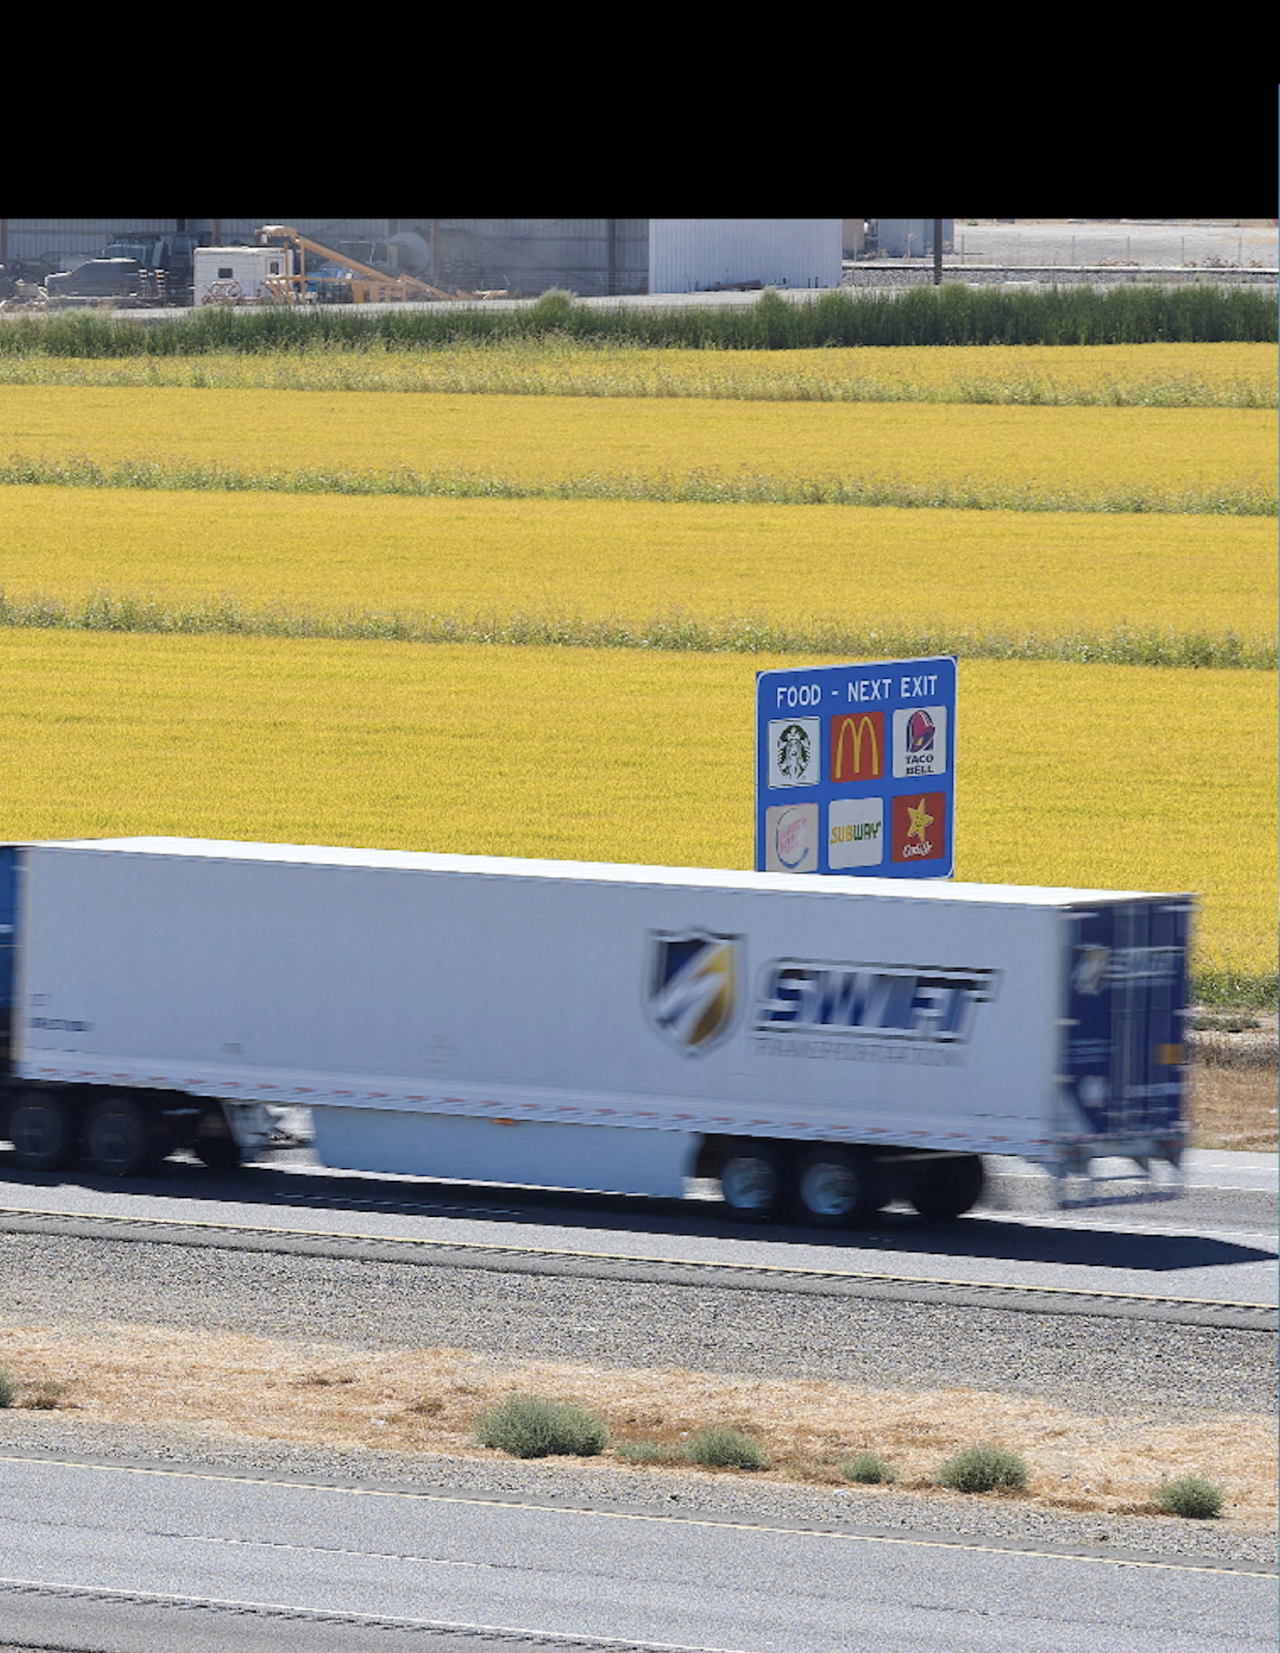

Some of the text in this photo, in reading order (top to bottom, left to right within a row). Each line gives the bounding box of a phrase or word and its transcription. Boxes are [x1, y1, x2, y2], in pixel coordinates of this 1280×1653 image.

[775, 684, 821, 709] FOOD
[847, 678, 893, 703] NEXT
[900, 674, 938, 698] EXIT
[905, 754, 934, 764] TACO
[906, 765, 934, 775] BELL
[830, 821, 881, 845] SUBWAY
